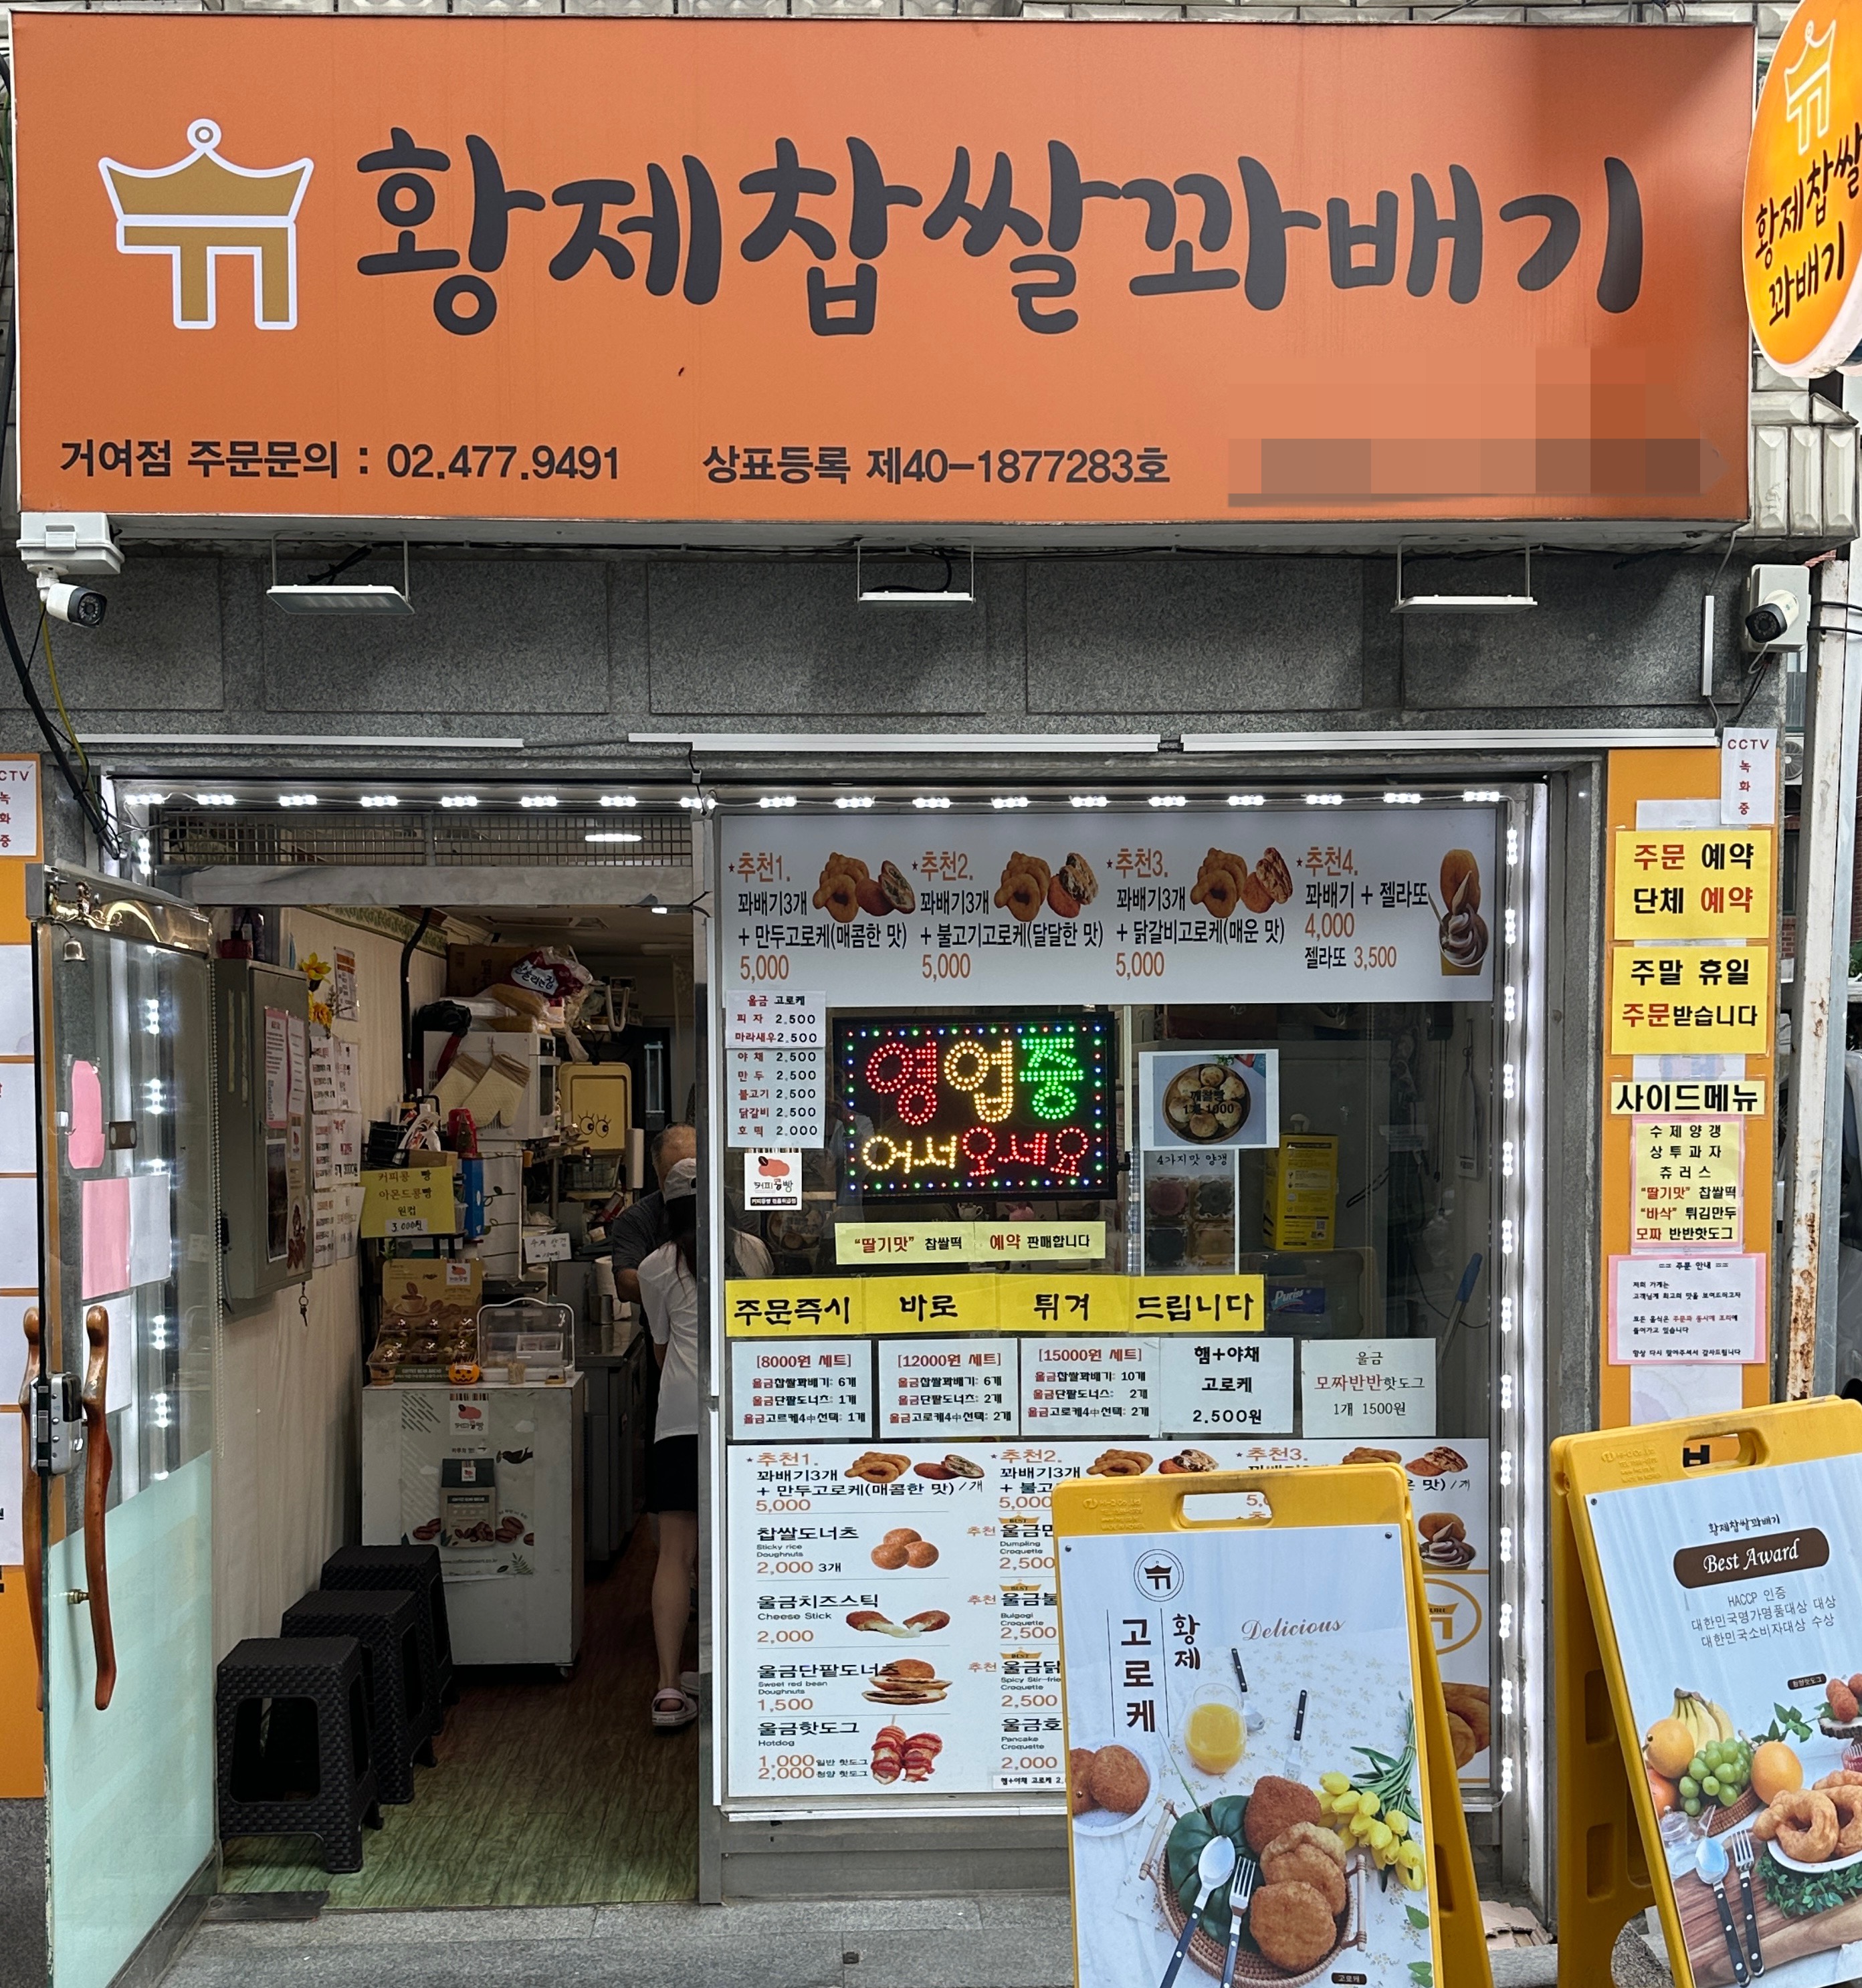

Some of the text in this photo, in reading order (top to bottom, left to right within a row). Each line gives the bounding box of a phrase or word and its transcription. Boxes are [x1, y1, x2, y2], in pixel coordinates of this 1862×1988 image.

[356, 125, 1644, 336] 황제찹쌀꽈배기
[1769, 221, 1845, 327] 꽈배기
[60, 439, 619, 481] 거여점 주문문의 02.477.9491
[702, 445, 851, 485] 상표등록
[1727, 739, 1770, 750] CCTV
[1115, 849, 1168, 879] 추천3.
[1305, 847, 1358, 877] 추천4.
[1634, 843, 1754, 870] 주문 예약
[737, 852, 791, 883] 추천1.
[920, 852, 973, 882] 추천2.
[1116, 886, 1186, 913] 꽈배기3개
[1305, 880, 1429, 909] 꽈배기 젤라또
[1633, 887, 1753, 915] 단체 예약
[738, 890, 808, 917] 꽈배기3개
[920, 889, 989, 916] 꽈배기3개
[1305, 911, 1355, 942] 4,000
[1305, 945, 1398, 971] 젤라또 3,500
[740, 954, 790, 984] 5,000
[922, 952, 971, 983] 5,000
[1116, 951, 1165, 981] 5,000
[1631, 958, 1750, 986] 주말 휴일
[774, 996, 805, 1006] 고로케
[775, 1014, 815, 1024] 2.500
[1622, 1003, 1758, 1028] 주문받습니다
[777, 1032, 817, 1043] 2.500
[776, 1052, 816, 1063] 2.500
[776, 1070, 816, 1081] 2.500
[865, 1038, 1084, 1126] 영업중
[738, 1089, 816, 1101] 불고기 2.500
[1616, 1083, 1758, 1113] 사이드메뉴
[738, 1107, 816, 1119] 닭갈비 2.500
[776, 1125, 817, 1136] 2.000
[1699, 1186, 1736, 1200] 찹쌀떡
[1685, 1206, 1737, 1220] 튀김만두
[1669, 1226, 1733, 1241] 반반핫도그
[925, 1236, 962, 1251] 찹쌀떡
[990, 1234, 1021, 1250] 예약
[1027, 1233, 1090, 1249] 판매합니다
[1675, 1261, 1711, 1271] 주문 안내
[734, 1292, 1254, 1327] 주문즉시 바로 튀겨 드립니다
[1194, 1346, 1260, 1363] 햄+야채
[838, 1376, 857, 1388] 6개
[984, 1375, 1002, 1387] 6개
[1121, 1371, 1146, 1382] 10개
[1314, 1374, 1426, 1392] 모짜반반핫도그
[1202, 1376, 1253, 1394] 고로케
[838, 1394, 857, 1406] 1개
[984, 1393, 1002, 1404] 2개
[1130, 1388, 1148, 1400] 2개
[848, 1412, 866, 1423] 1개
[993, 1411, 1011, 1422] 2개
[1131, 1406, 1150, 1417] 2개
[1193, 1409, 1262, 1426] 2.500원
[1334, 1402, 1407, 1418] 1개 1500원
[756, 1452, 819, 1467] 추천1.
[1000, 1450, 1062, 1464] 추천2.
[1246, 1447, 1309, 1462] 추천3.
[756, 1469, 838, 1482] 꽈배기3개
[1001, 1466, 1081, 1479] 꽈배기3개
[756, 1498, 811, 1515] 5,000
[999, 1495, 1052, 1511] 5,000
[967, 1526, 996, 1537] 추천
[1708, 1513, 1781, 1536] 황제찹쌀꽈배기
[756, 1527, 859, 1541] 찹쌀도너츠
[1703, 1537, 1800, 1574] Best Award
[756, 1561, 841, 1575] 2,000 3개
[999, 1557, 1055, 1571] 2,500
[756, 1594, 880, 1610] 울금치즈스틱
[967, 1594, 997, 1605] 추천
[1727, 1585, 1786, 1608] HACCP 인증
[805, 1612, 832, 1620] Stick
[1691, 1594, 1837, 1632] 대한민국명가명품대상 대상
[757, 1630, 814, 1644] 2,000
[1000, 1627, 1057, 1640] 2,500
[1241, 1619, 1346, 1642] Delicious
[1701, 1613, 1835, 1649] 대한민국소비자대상 수상
[1172, 1612, 1201, 1671] 황제
[968, 1662, 997, 1672] 추천
[1120, 1618, 1157, 1734] 고로케
[758, 1698, 813, 1713] 1,500
[1001, 1694, 1057, 1708] 2,500
[758, 1721, 859, 1736] 울금핫도그
[758, 1739, 795, 1747] Hotdog
[759, 1755, 815, 1768] 1,000
[1001, 1757, 1057, 1771] 2,000
[758, 1767, 815, 1780] 2,000
